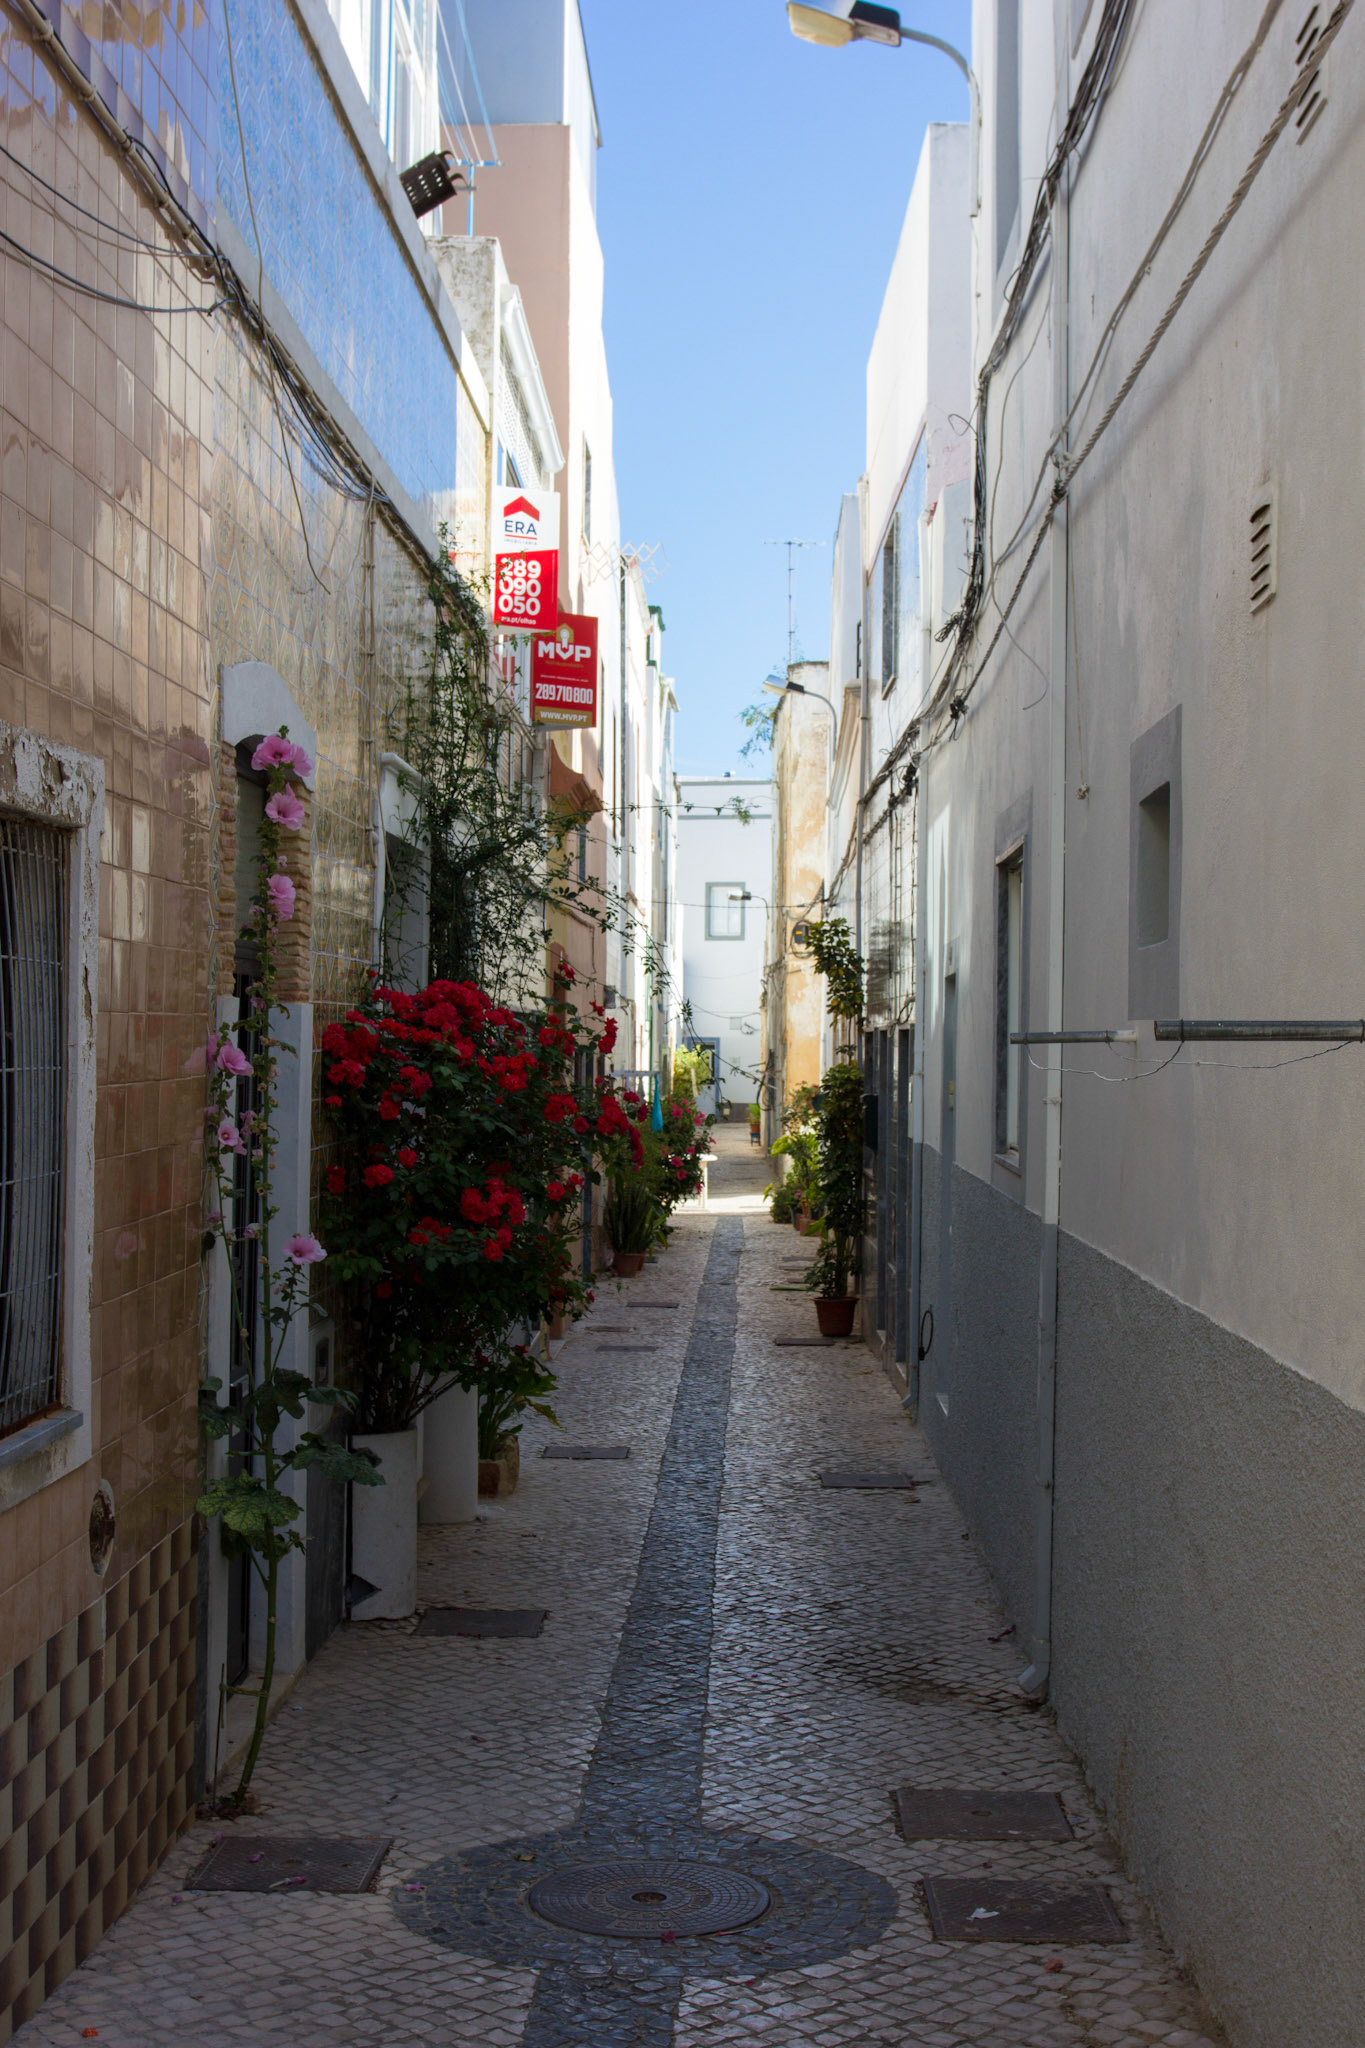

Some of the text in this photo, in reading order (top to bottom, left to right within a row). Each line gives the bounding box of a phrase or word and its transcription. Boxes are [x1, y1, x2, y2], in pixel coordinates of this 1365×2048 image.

[505, 520, 537, 535] ERA
[500, 557, 541, 579] 289
[499, 576, 541, 597] 090
[498, 594, 541, 615] 050
[538, 641, 591, 662] MVP
[540, 711, 588, 722] WWW.MVP.PT
